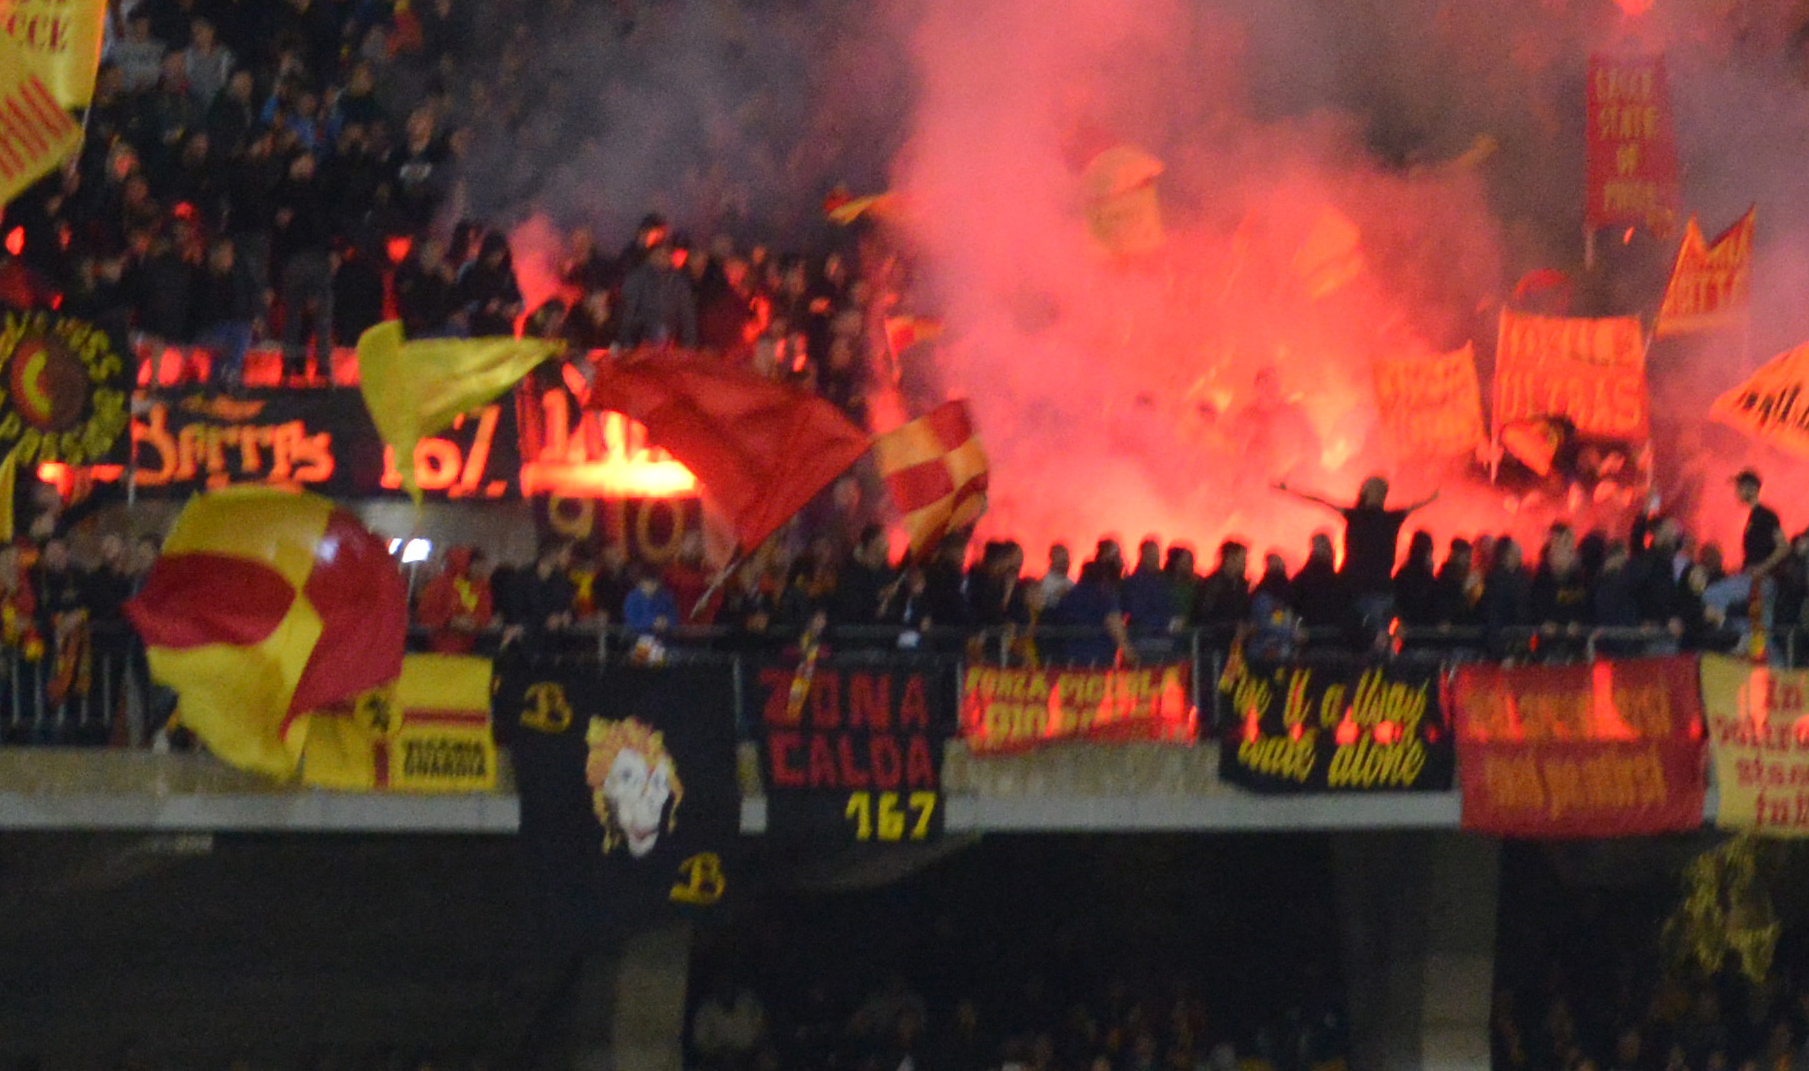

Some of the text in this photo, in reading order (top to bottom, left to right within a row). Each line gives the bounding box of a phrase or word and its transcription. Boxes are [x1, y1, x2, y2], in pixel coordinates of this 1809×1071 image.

[519, 680, 574, 734] B
[758, 667, 929, 729] ZONA
[768, 730, 936, 788] CALDA
[1327, 729, 1428, 789] alone
[845, 789, 938, 843] 167
[669, 851, 727, 907] B
